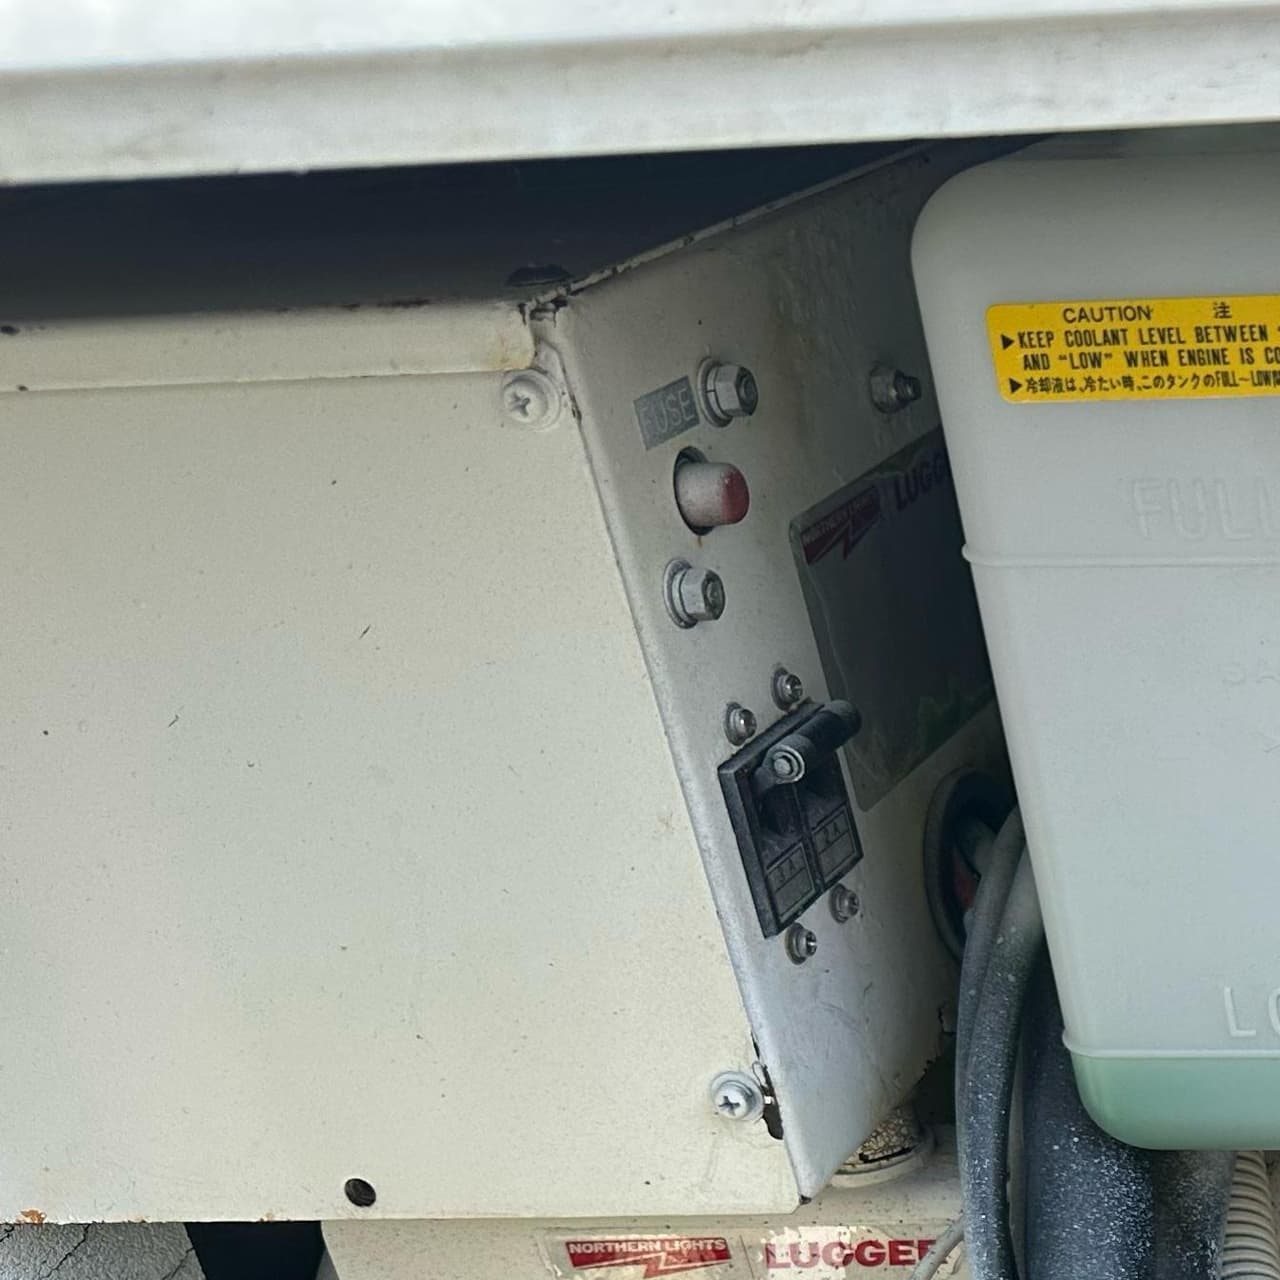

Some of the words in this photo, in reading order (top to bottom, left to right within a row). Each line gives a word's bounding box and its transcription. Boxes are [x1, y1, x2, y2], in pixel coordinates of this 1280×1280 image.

[1063, 305, 1153, 324] CAUTION
[1213, 301, 1232, 320] 注
[1018, 331, 1055, 349] KEEP
[1065, 329, 1128, 348] COOLANT
[1138, 327, 1186, 345] LEVEL
[1196, 324, 1268, 343] BETWEEN
[1023, 352, 1050, 371] AND
[1124, 349, 1168, 368] WHEN
[1178, 348, 1228, 366] ENGINE
[1240, 347, 1254, 365] IS
[893, 450, 945, 511] LUGG
[568, 1240, 662, 1255] NORTHERN
[663, 1237, 727, 1254] LIGHTS
[765, 1238, 950, 1269] LUGGE
